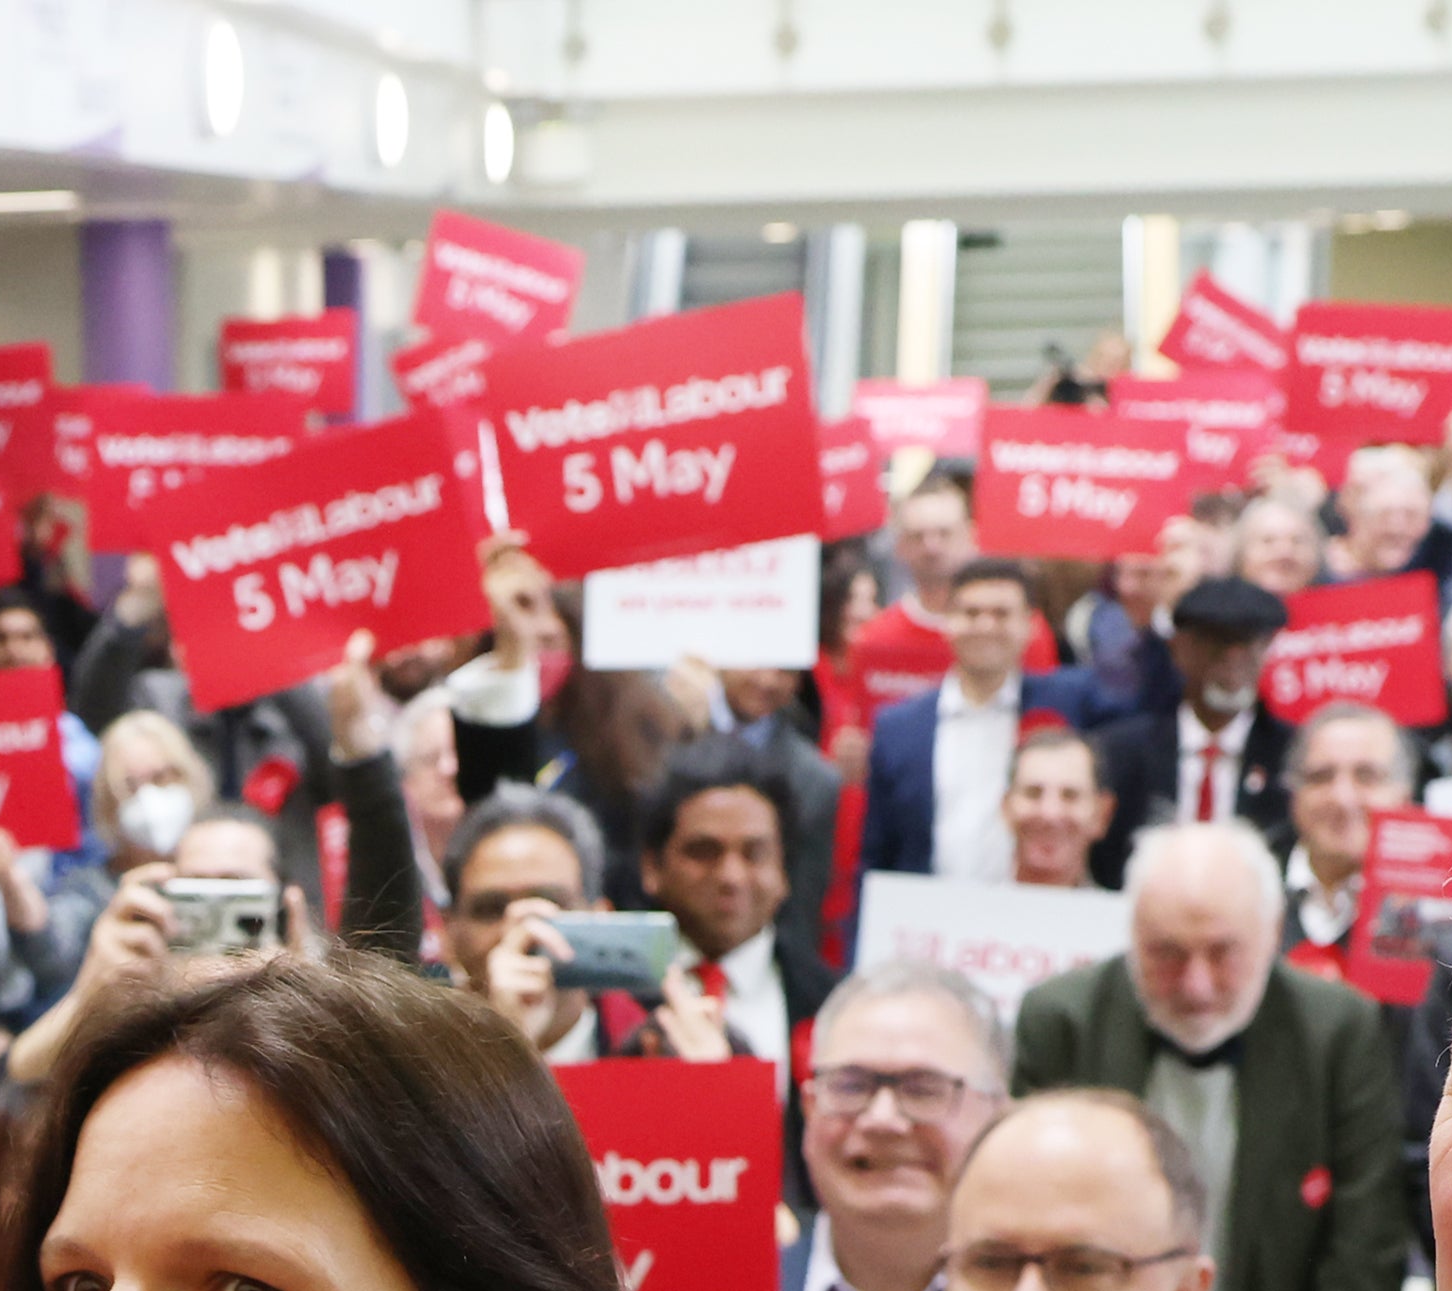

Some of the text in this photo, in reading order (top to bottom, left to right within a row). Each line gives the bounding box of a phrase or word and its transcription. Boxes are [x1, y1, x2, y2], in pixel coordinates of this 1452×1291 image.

[505, 398, 617, 453] Vote
[642, 364, 793, 428] Labour
[561, 437, 738, 514] 5 May
[170, 472, 444, 581] Vote Labour
[231, 548, 399, 632] 5 May
